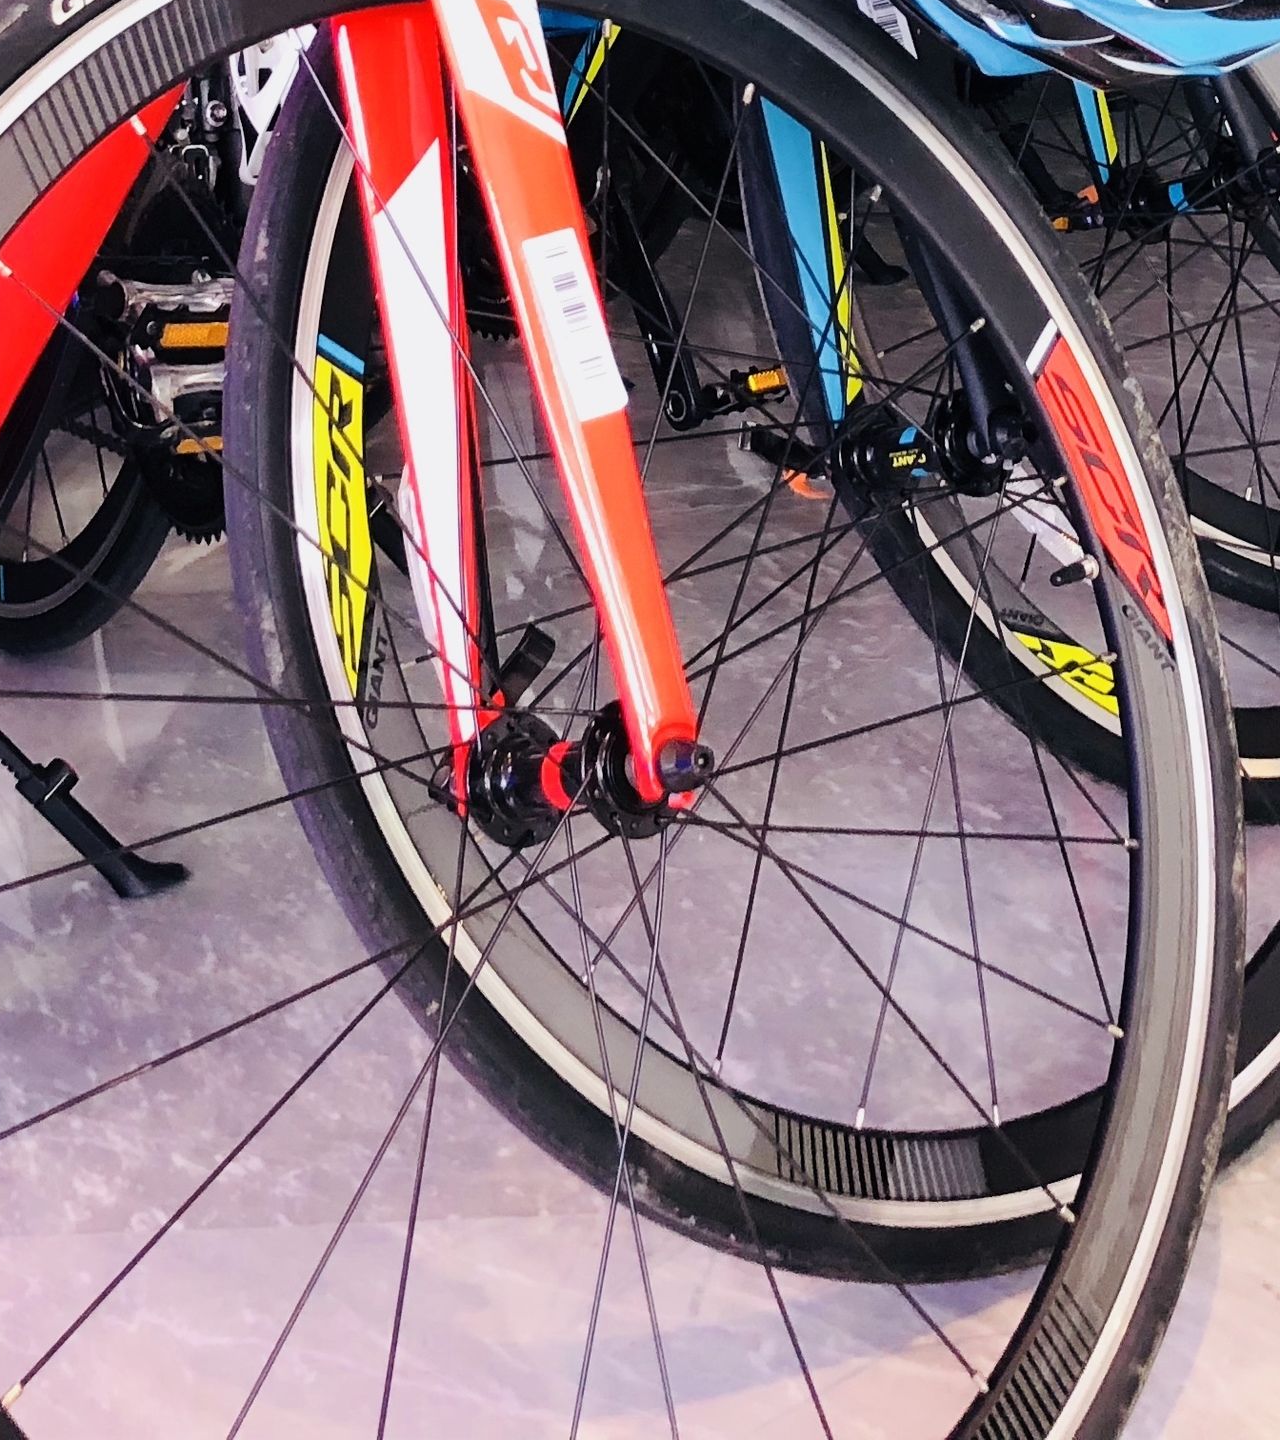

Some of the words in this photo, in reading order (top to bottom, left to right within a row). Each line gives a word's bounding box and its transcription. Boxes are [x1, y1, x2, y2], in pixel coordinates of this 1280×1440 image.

[892, 452, 927, 468] GANT
[1042, 371, 1166, 609] SCR
[322, 368, 358, 675] SCR
[365, 632, 389, 729] GIANT
[1121, 604, 1176, 673] GIANT
